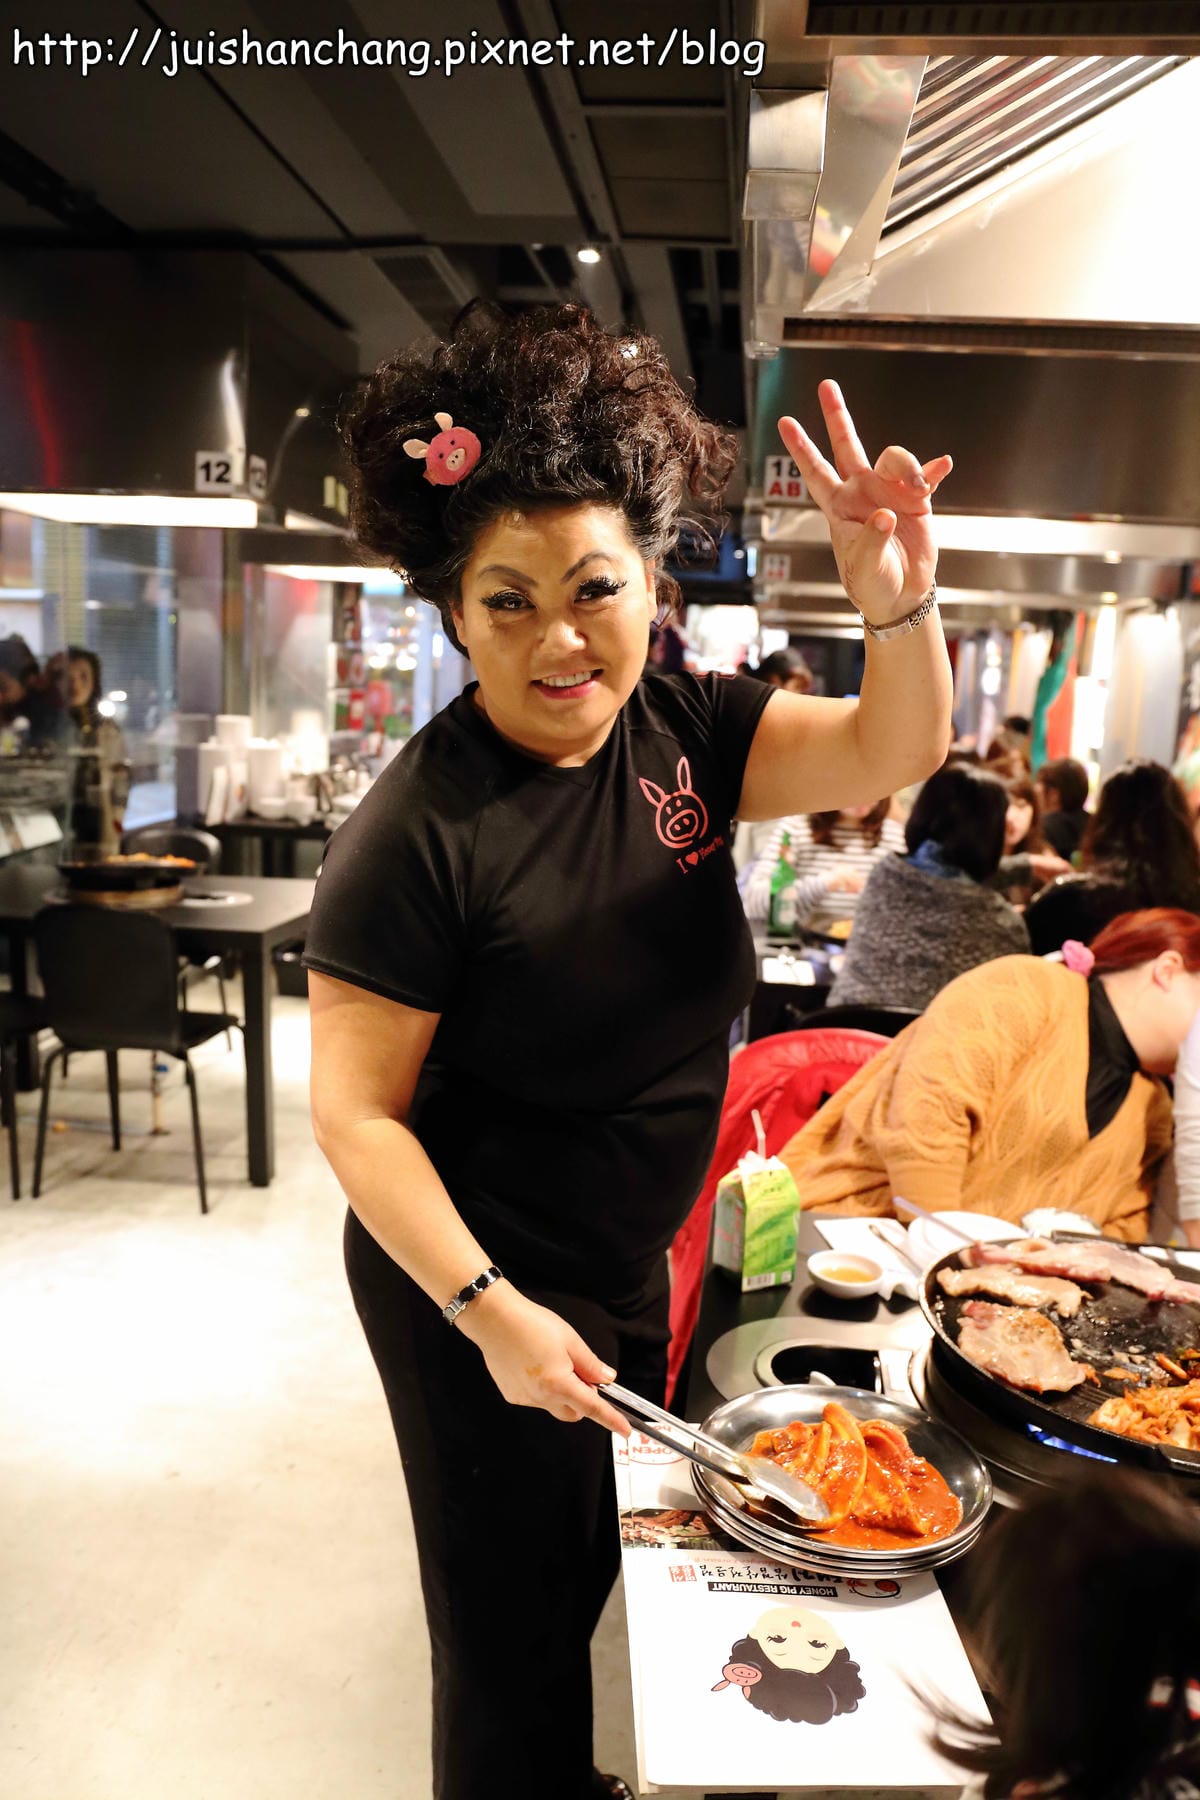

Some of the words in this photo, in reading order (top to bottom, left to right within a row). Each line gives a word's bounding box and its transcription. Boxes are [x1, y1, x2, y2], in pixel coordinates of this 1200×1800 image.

[199, 461, 231, 483] 12
[769, 481, 801, 497] AB
[632, 1446, 673, 1455] OPEN
[712, 1582, 778, 1593] RESTAURANT
[780, 1585, 797, 1594] PIG
[799, 1587, 834, 1596] HONEY
